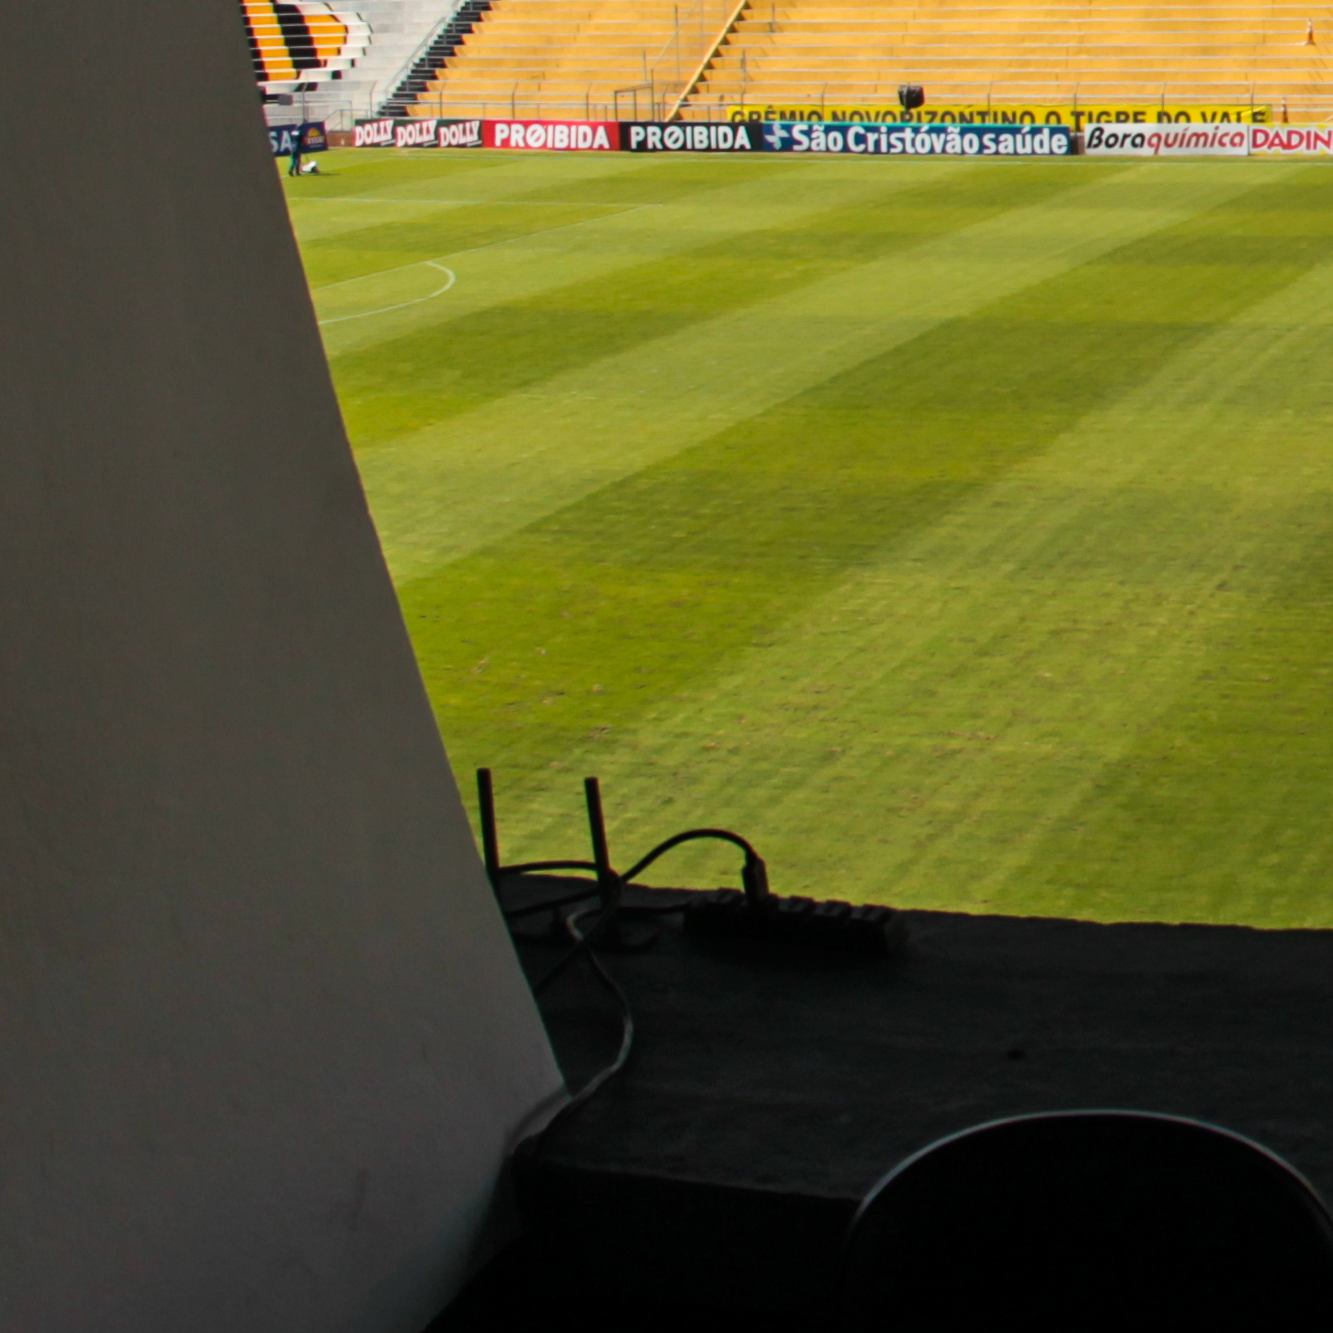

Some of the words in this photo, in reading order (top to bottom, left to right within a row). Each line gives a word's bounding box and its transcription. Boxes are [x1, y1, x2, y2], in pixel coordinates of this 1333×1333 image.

[731, 105, 824, 123] GRÊMIO
[1070, 110, 1147, 132] TIGRE
[355, 119, 395, 146] DOLLY
[396, 119, 437, 146] DOLLY
[440, 119, 481, 146] DOLLY
[792, 123, 844, 152] São
[847, 125, 980, 155] Cristóvão
[983, 126, 1069, 155] saúde
